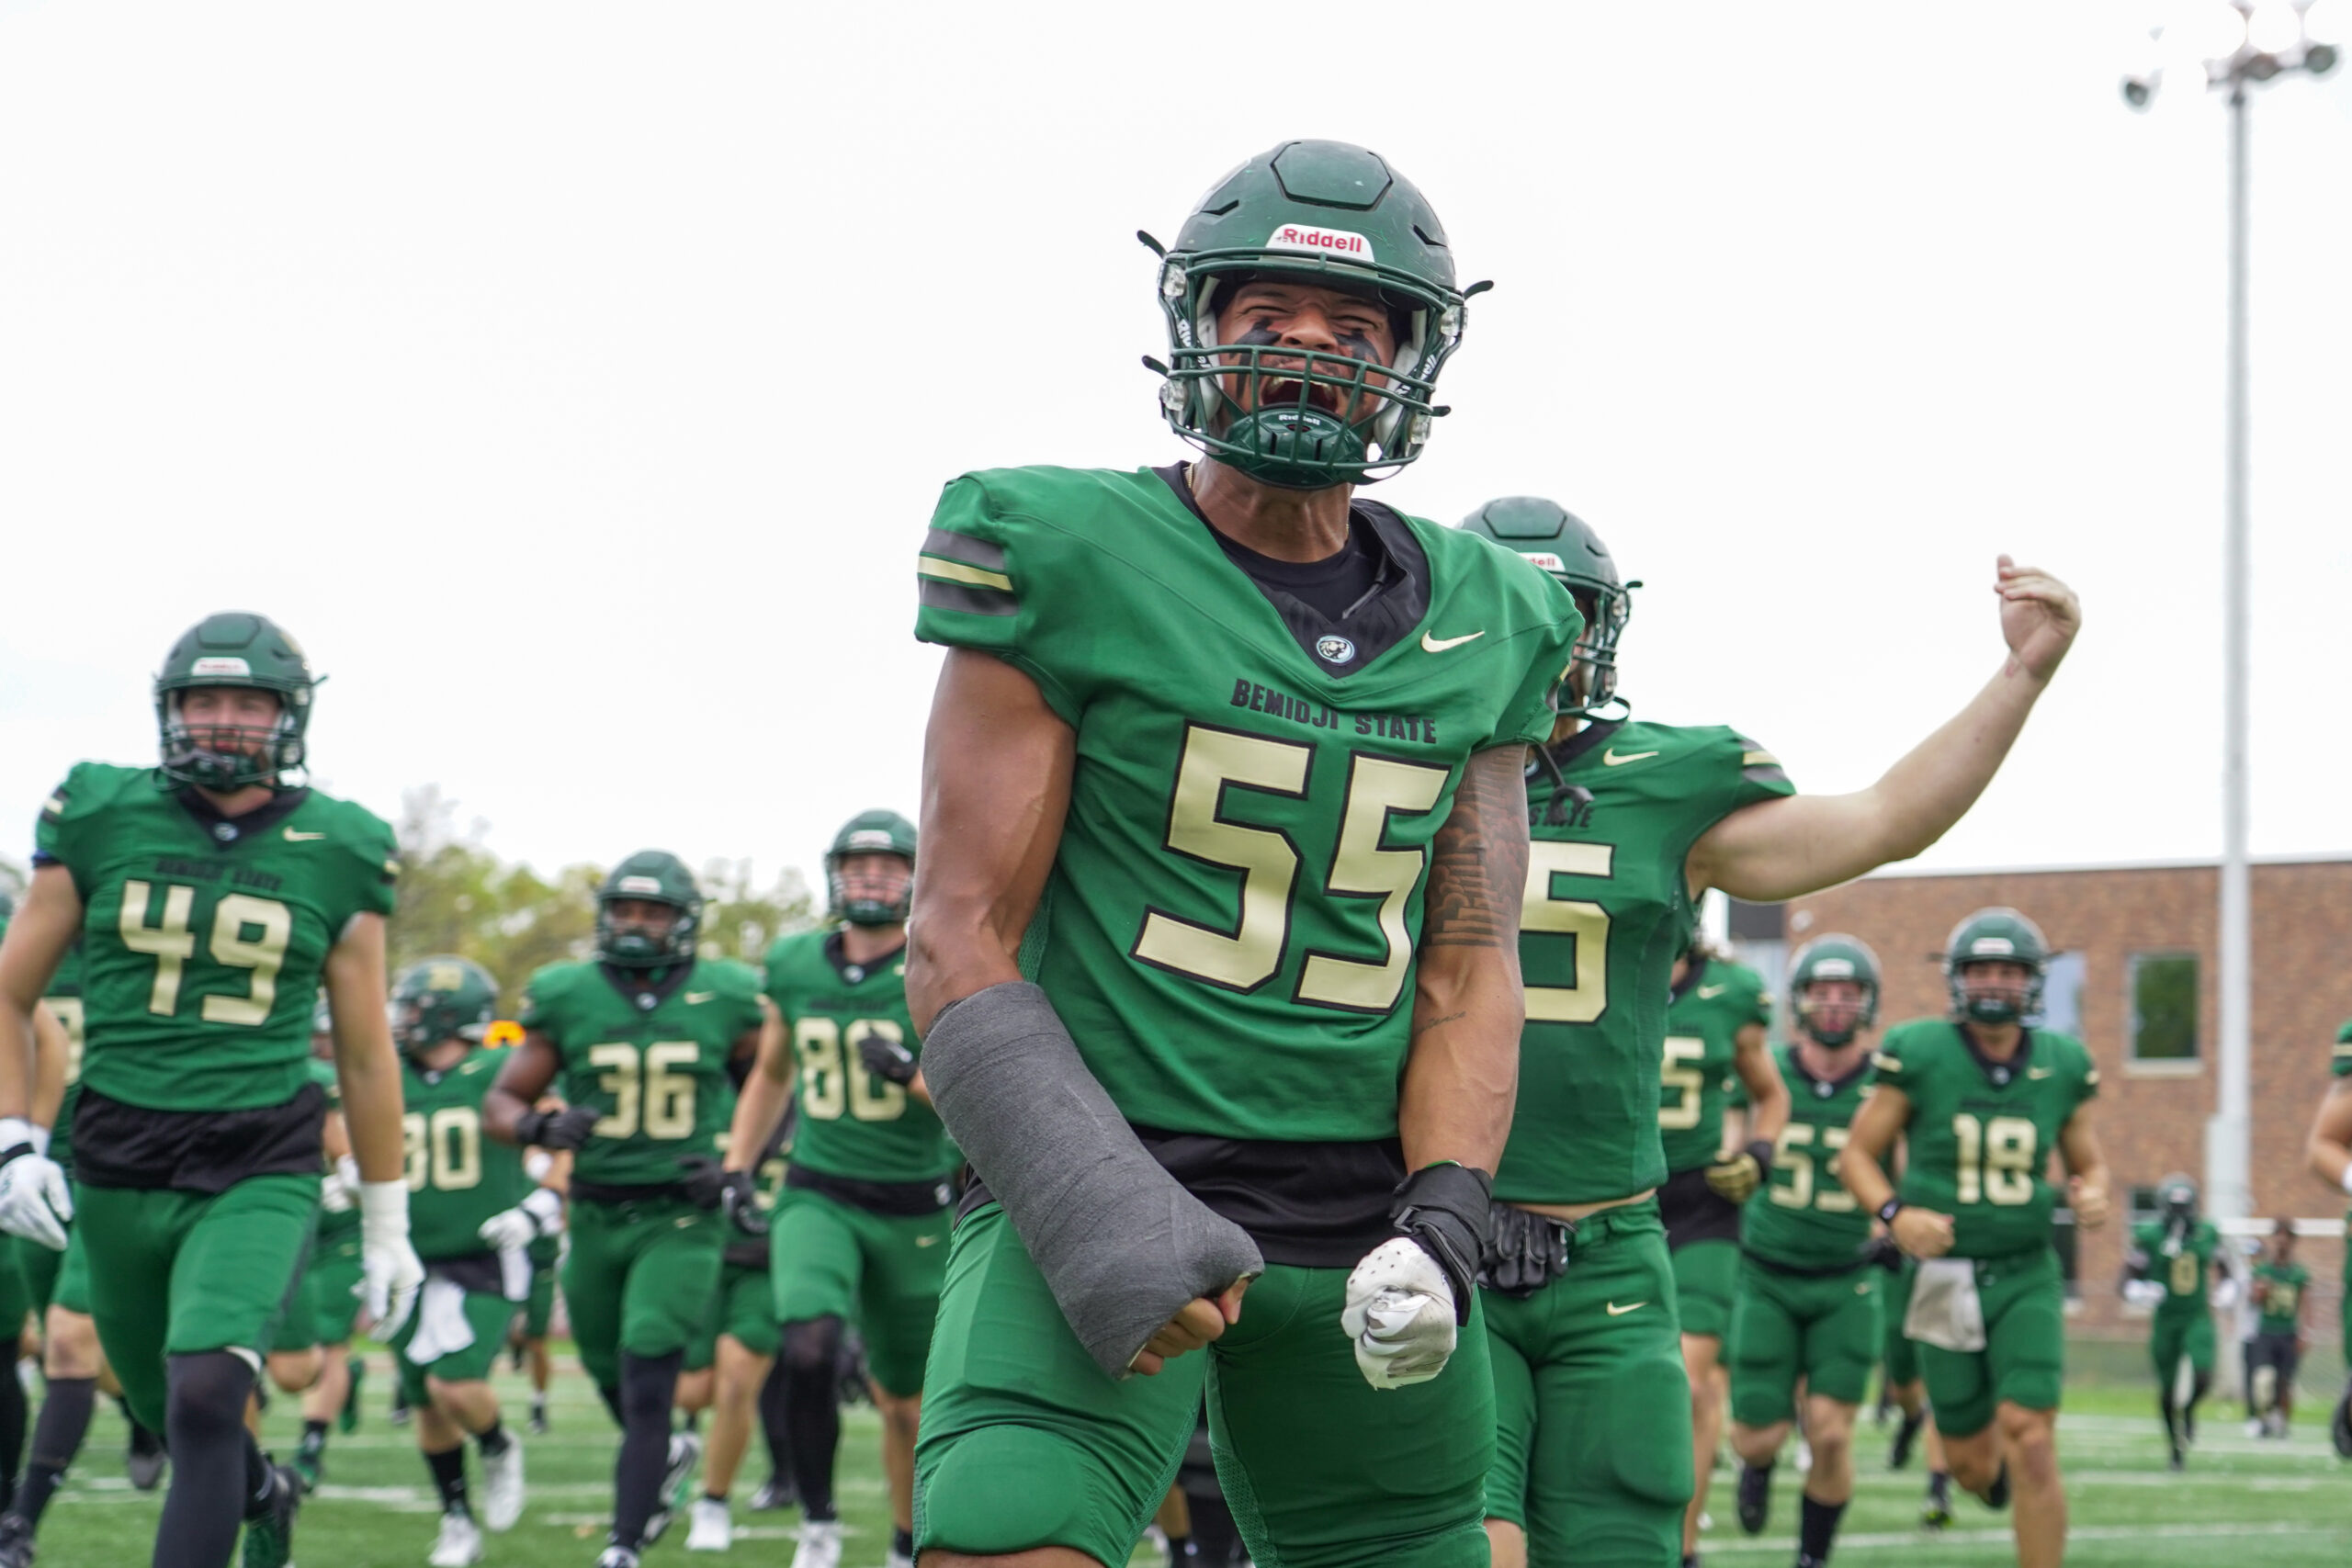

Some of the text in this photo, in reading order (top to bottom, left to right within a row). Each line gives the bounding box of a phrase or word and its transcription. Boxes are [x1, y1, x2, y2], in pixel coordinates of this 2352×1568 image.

[1283, 228, 1363, 253] Riddell
[1278, 413, 1322, 426] Ridell
[1229, 678, 1438, 744] BEMIDJI STATE
[1129, 718, 1453, 1015] 55
[119, 879, 291, 1027] 49
[590, 1041, 699, 1140] 36
[1951, 1112, 2038, 1206] 18
